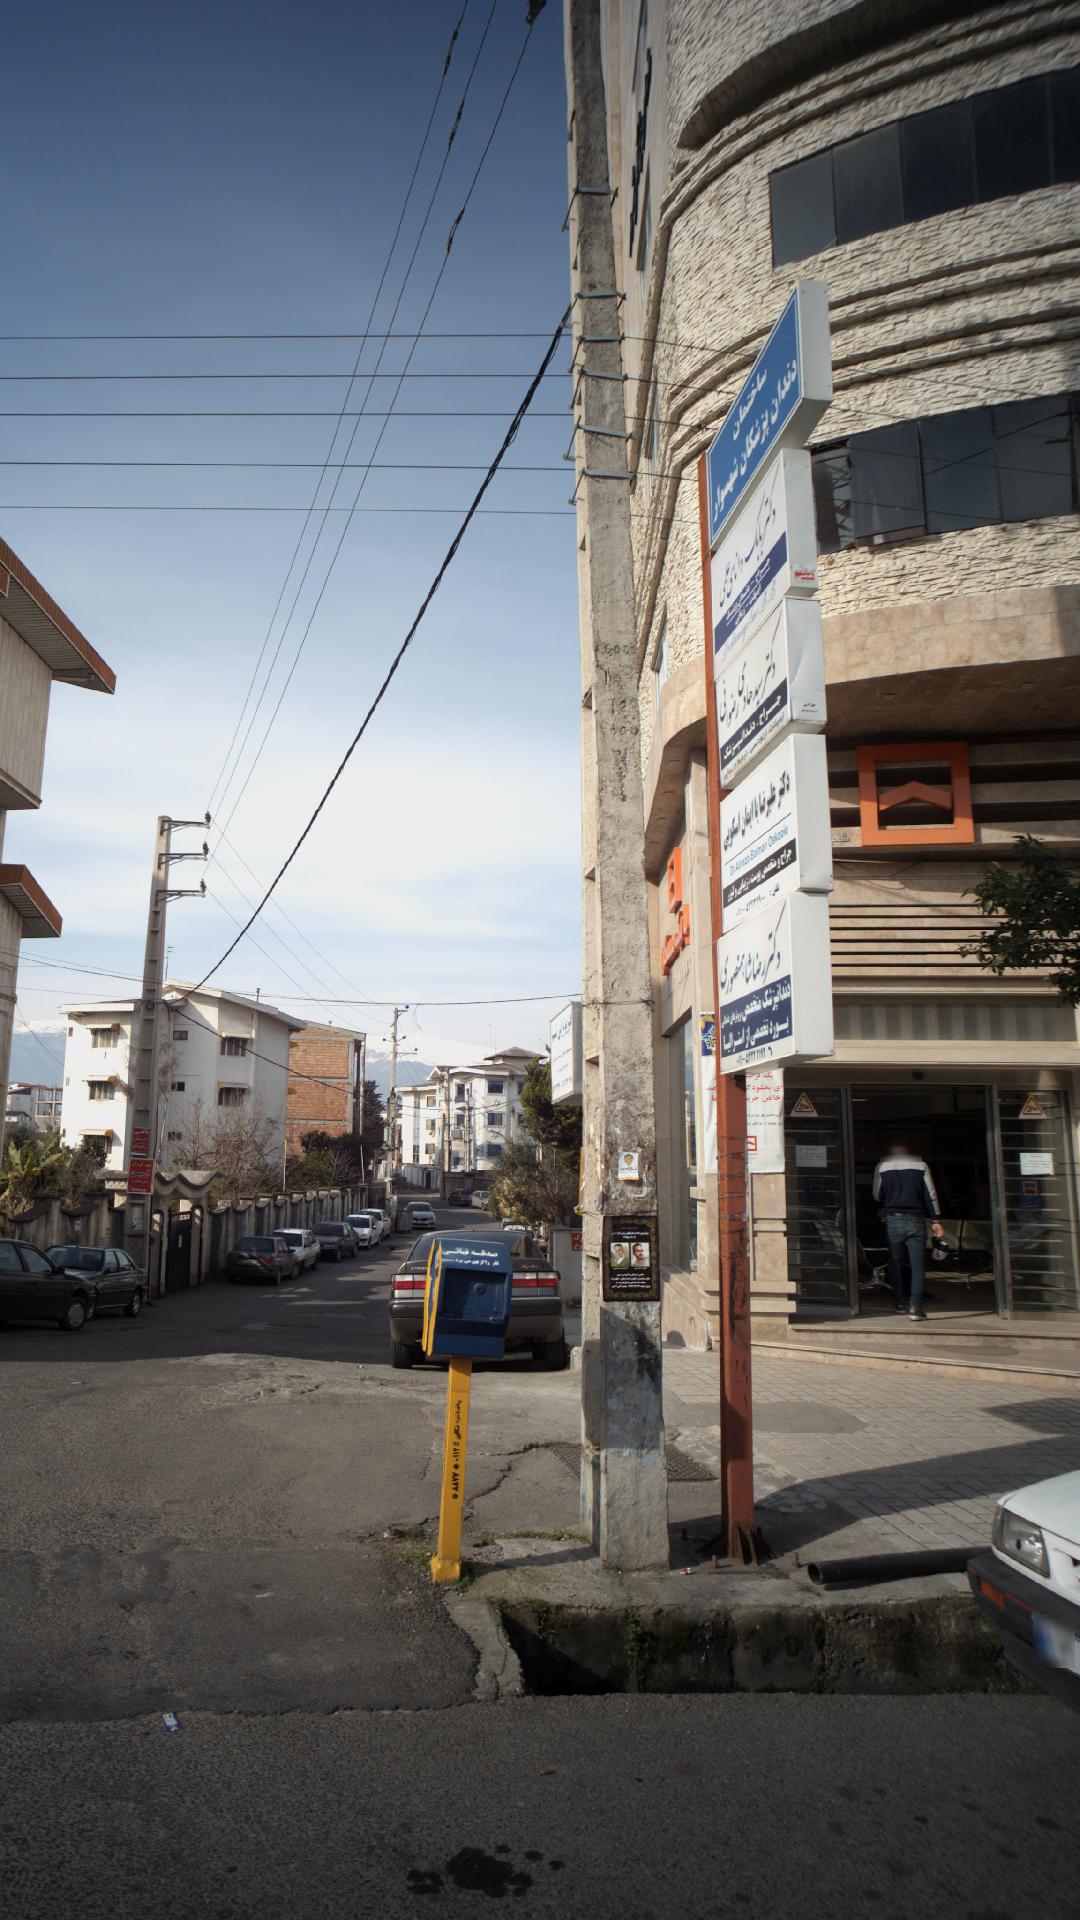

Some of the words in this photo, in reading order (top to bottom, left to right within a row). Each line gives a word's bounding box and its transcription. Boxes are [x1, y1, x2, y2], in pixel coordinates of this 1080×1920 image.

[732, 367, 767, 441] ساختمان
[777, 770, 790, 809] دکتر
[764, 899, 786, 984] دکتر
